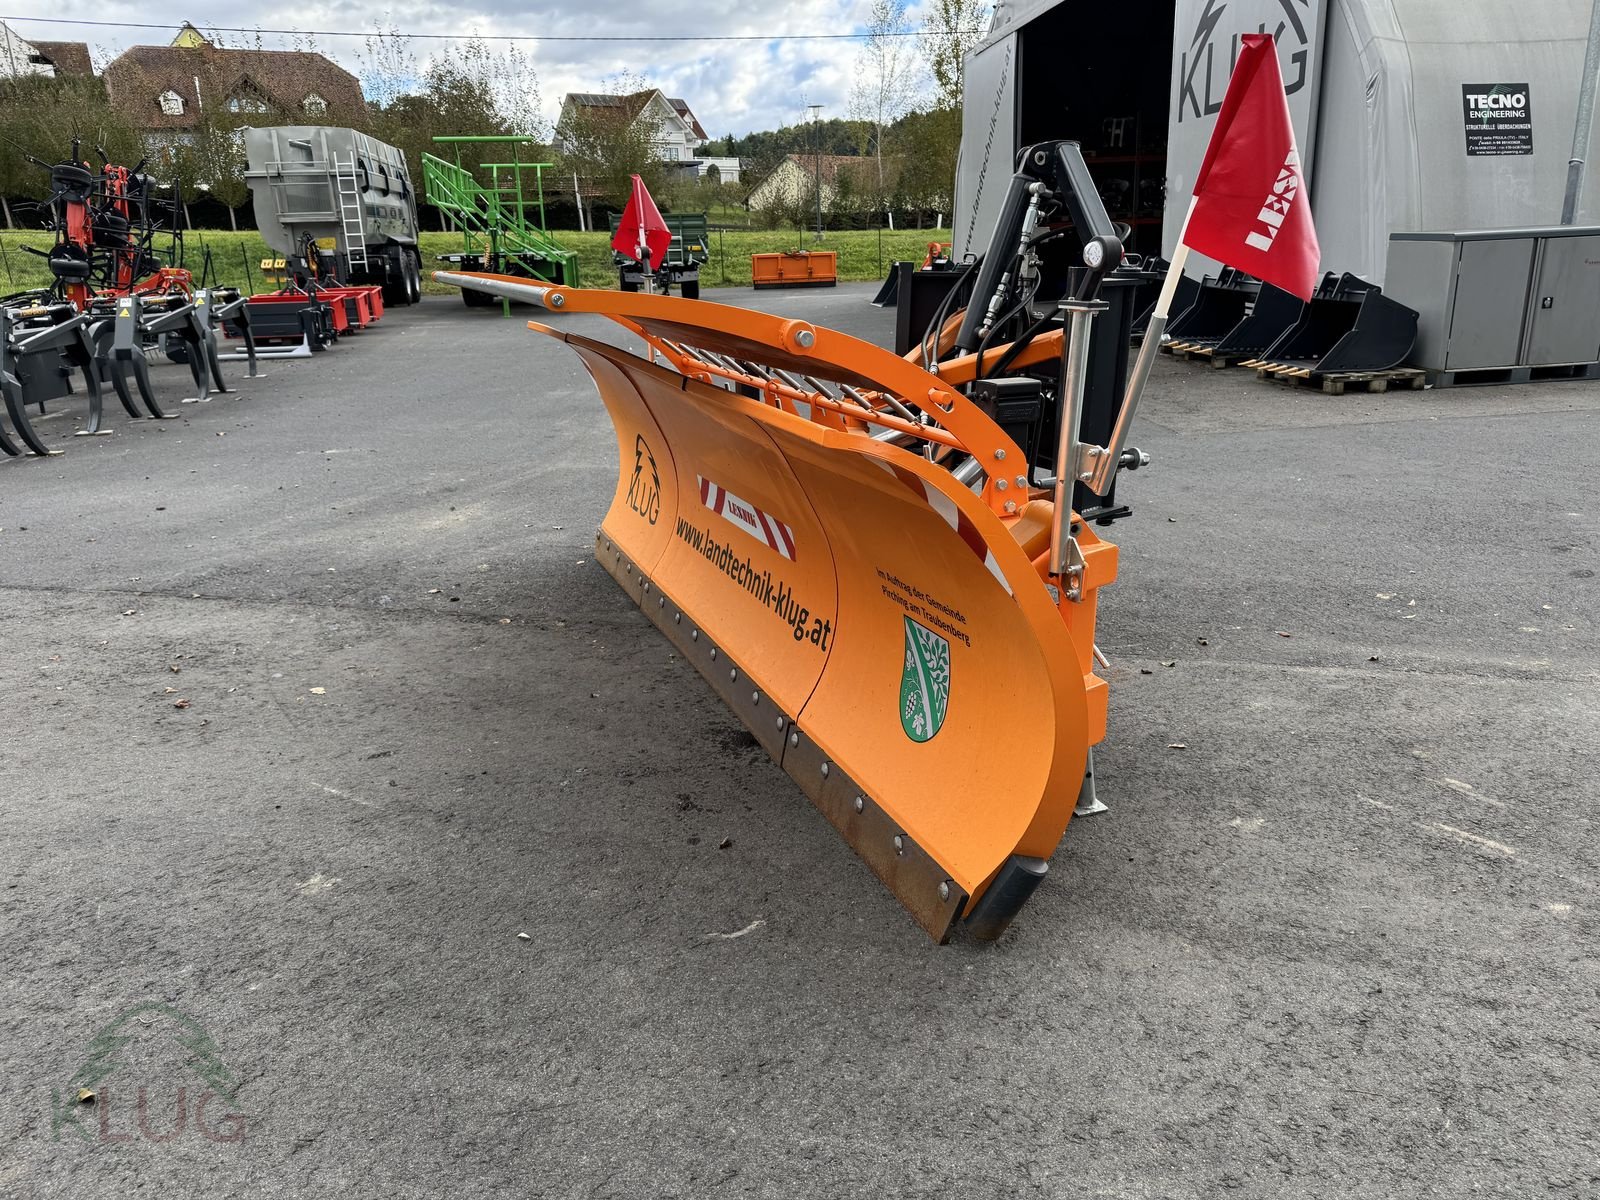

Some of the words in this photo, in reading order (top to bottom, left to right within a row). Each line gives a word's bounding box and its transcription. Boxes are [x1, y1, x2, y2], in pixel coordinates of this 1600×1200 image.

[1466, 93, 1526, 109] TECNO
[1469, 110, 1526, 118] ENGINEERING
[626, 473, 660, 525] KLUG
[676, 515, 831, 652] www.landtechnik-klug.at
[887, 572, 913, 597] Auftrag
[912, 586, 925, 601] der
[925, 594, 967, 625] Gemeinde
[881, 585, 910, 611] Pirching
[909, 602, 921, 615] am
[921, 607, 971, 648] Traubenberg
